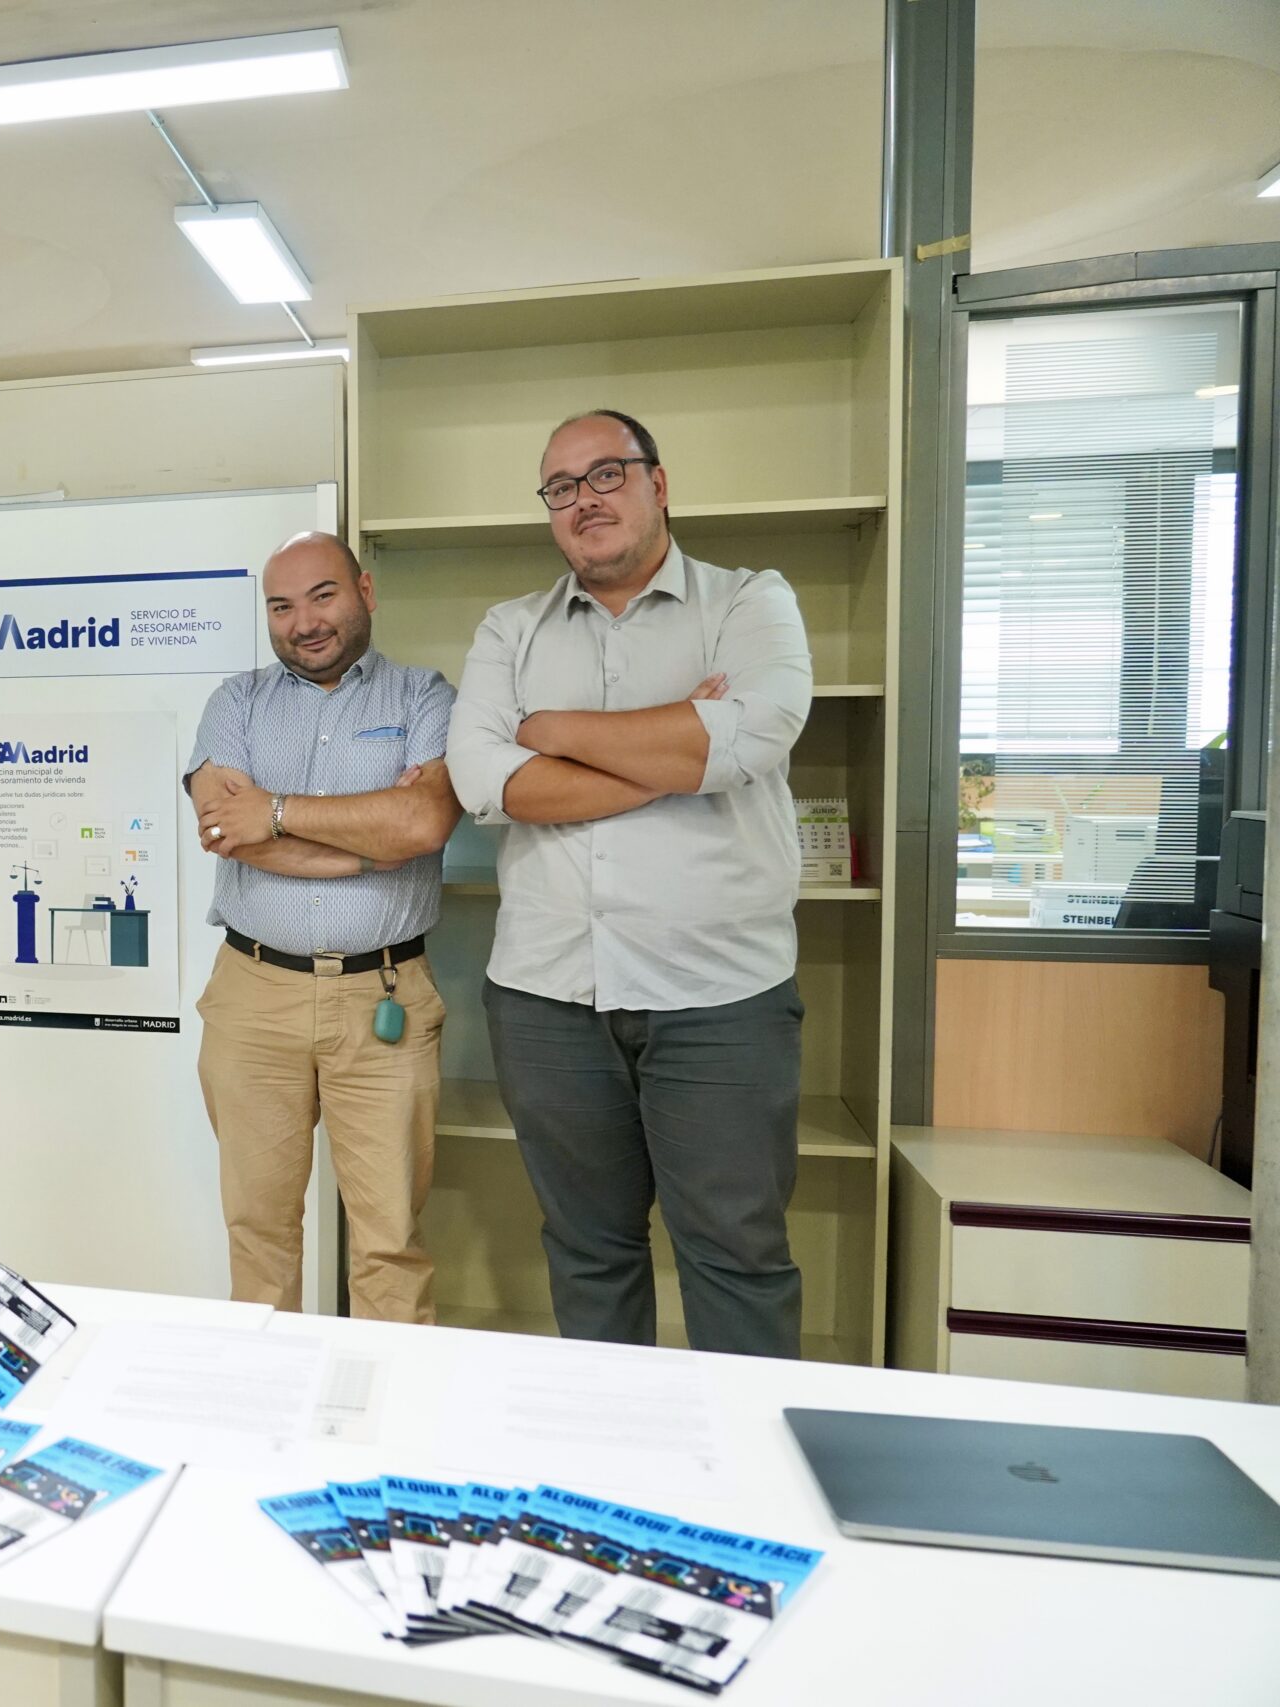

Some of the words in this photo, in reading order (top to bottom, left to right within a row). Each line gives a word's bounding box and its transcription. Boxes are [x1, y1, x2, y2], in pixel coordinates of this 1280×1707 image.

[130, 609, 180, 620] SERVICIO
[182, 608, 197, 618] DE
[130, 621, 222, 633] ASESORAMIENTO
[130, 637, 145, 647] DE
[147, 635, 197, 646] VIVIENDA
[15, 767, 52, 777] municipal
[53, 767, 64, 775] de
[43, 776, 54, 785] de
[55, 775, 86, 784] vivienda
[1067, 894, 1121, 904] STEINBEI
[1063, 914, 1116, 925] STEINBEI
[142, 1020, 176, 1029] MADRID
[336, 1485, 381, 1498] ALQU
[387, 1478, 458, 1498] ALQUILA
[677, 1526, 755, 1551] ALQUILA
